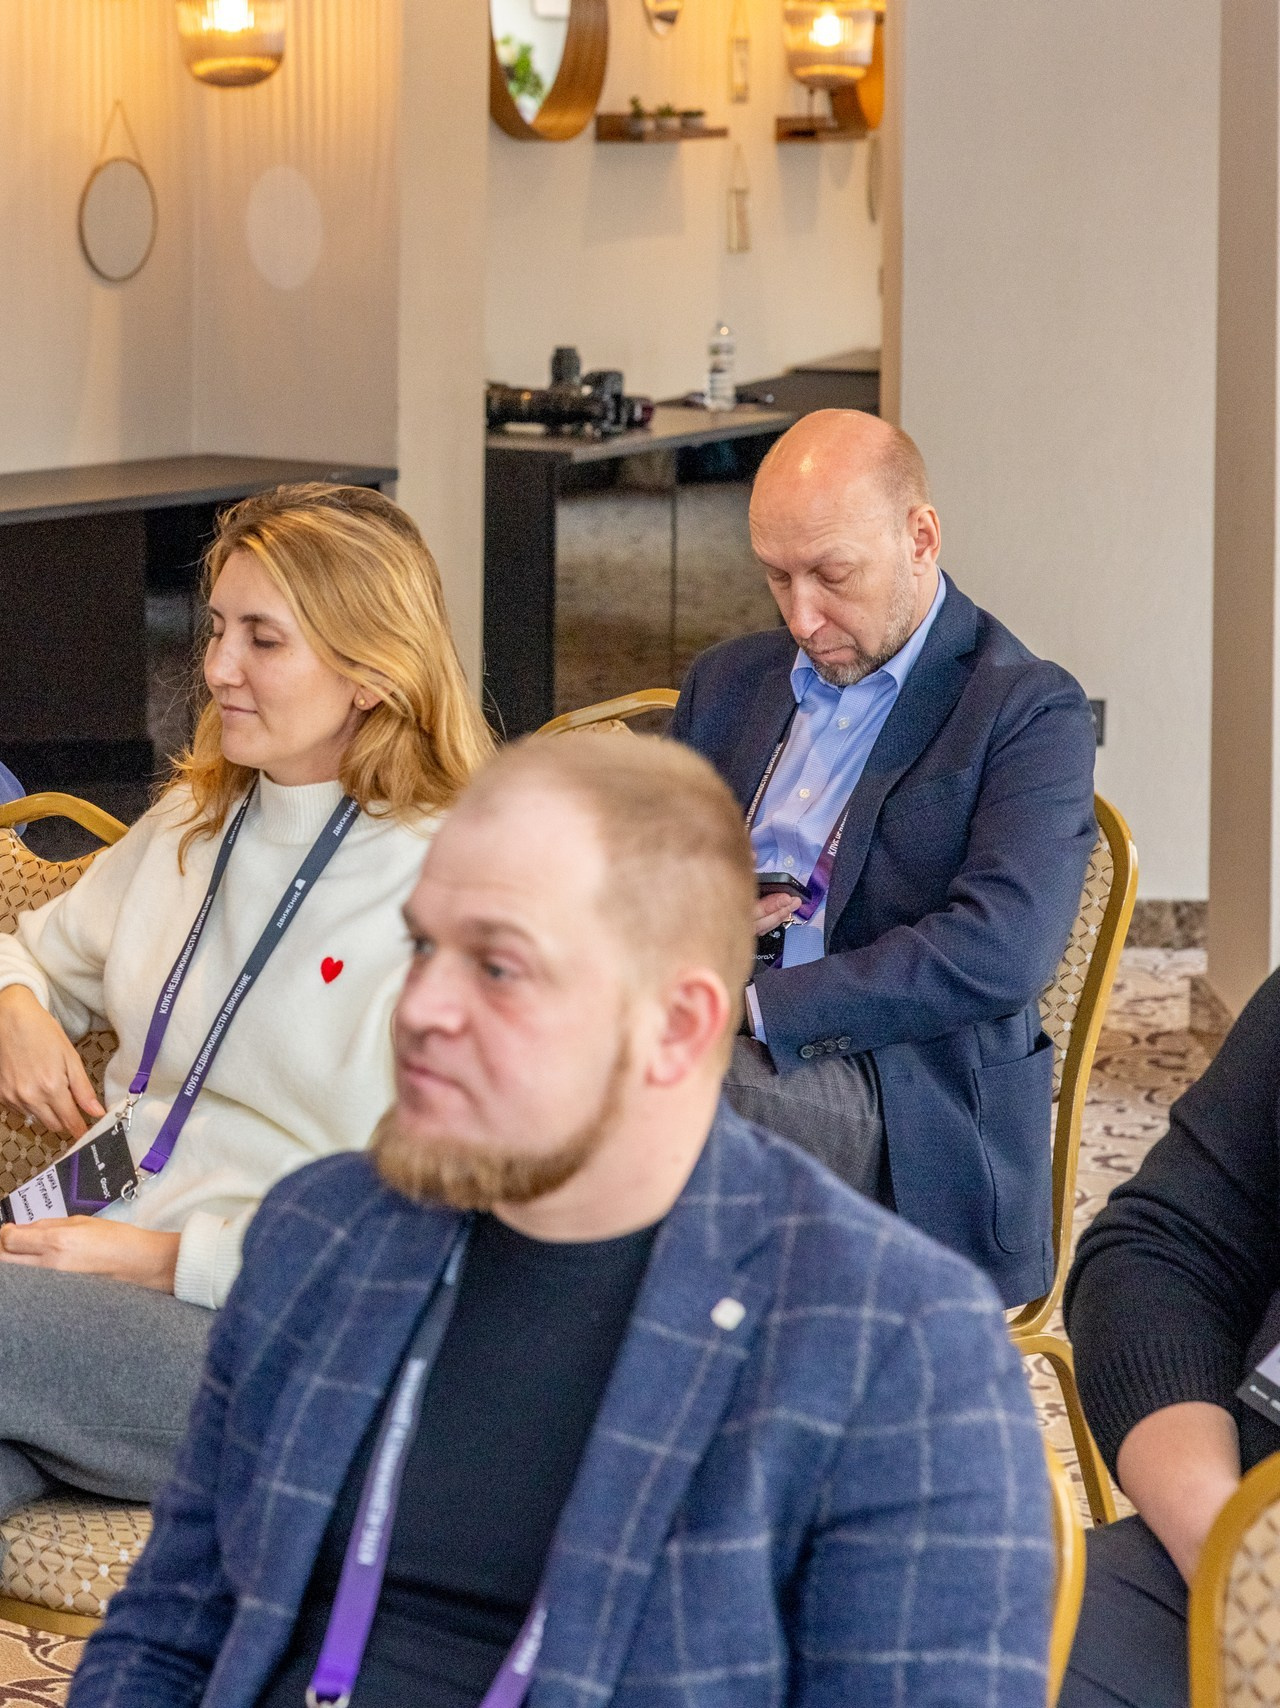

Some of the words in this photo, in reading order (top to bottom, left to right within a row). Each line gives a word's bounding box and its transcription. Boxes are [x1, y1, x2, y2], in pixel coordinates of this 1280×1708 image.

[332, 800, 358, 837] ДВИЖЕНИЕ
[276, 890, 302, 929] ДВИЖЕНИЕ
[159, 993, 173, 1014] КЛУБ
[166, 933, 197, 993] НЕДВИЖИМОСТИ
[193, 894, 214, 934] ДВИЖЕНИЕ
[184, 1073, 200, 1097] КЛУБ
[193, 1012, 229, 1075] НЕДВИЖИМОСТИ
[224, 972, 252, 1015] ДВИЖЕНИЕ
